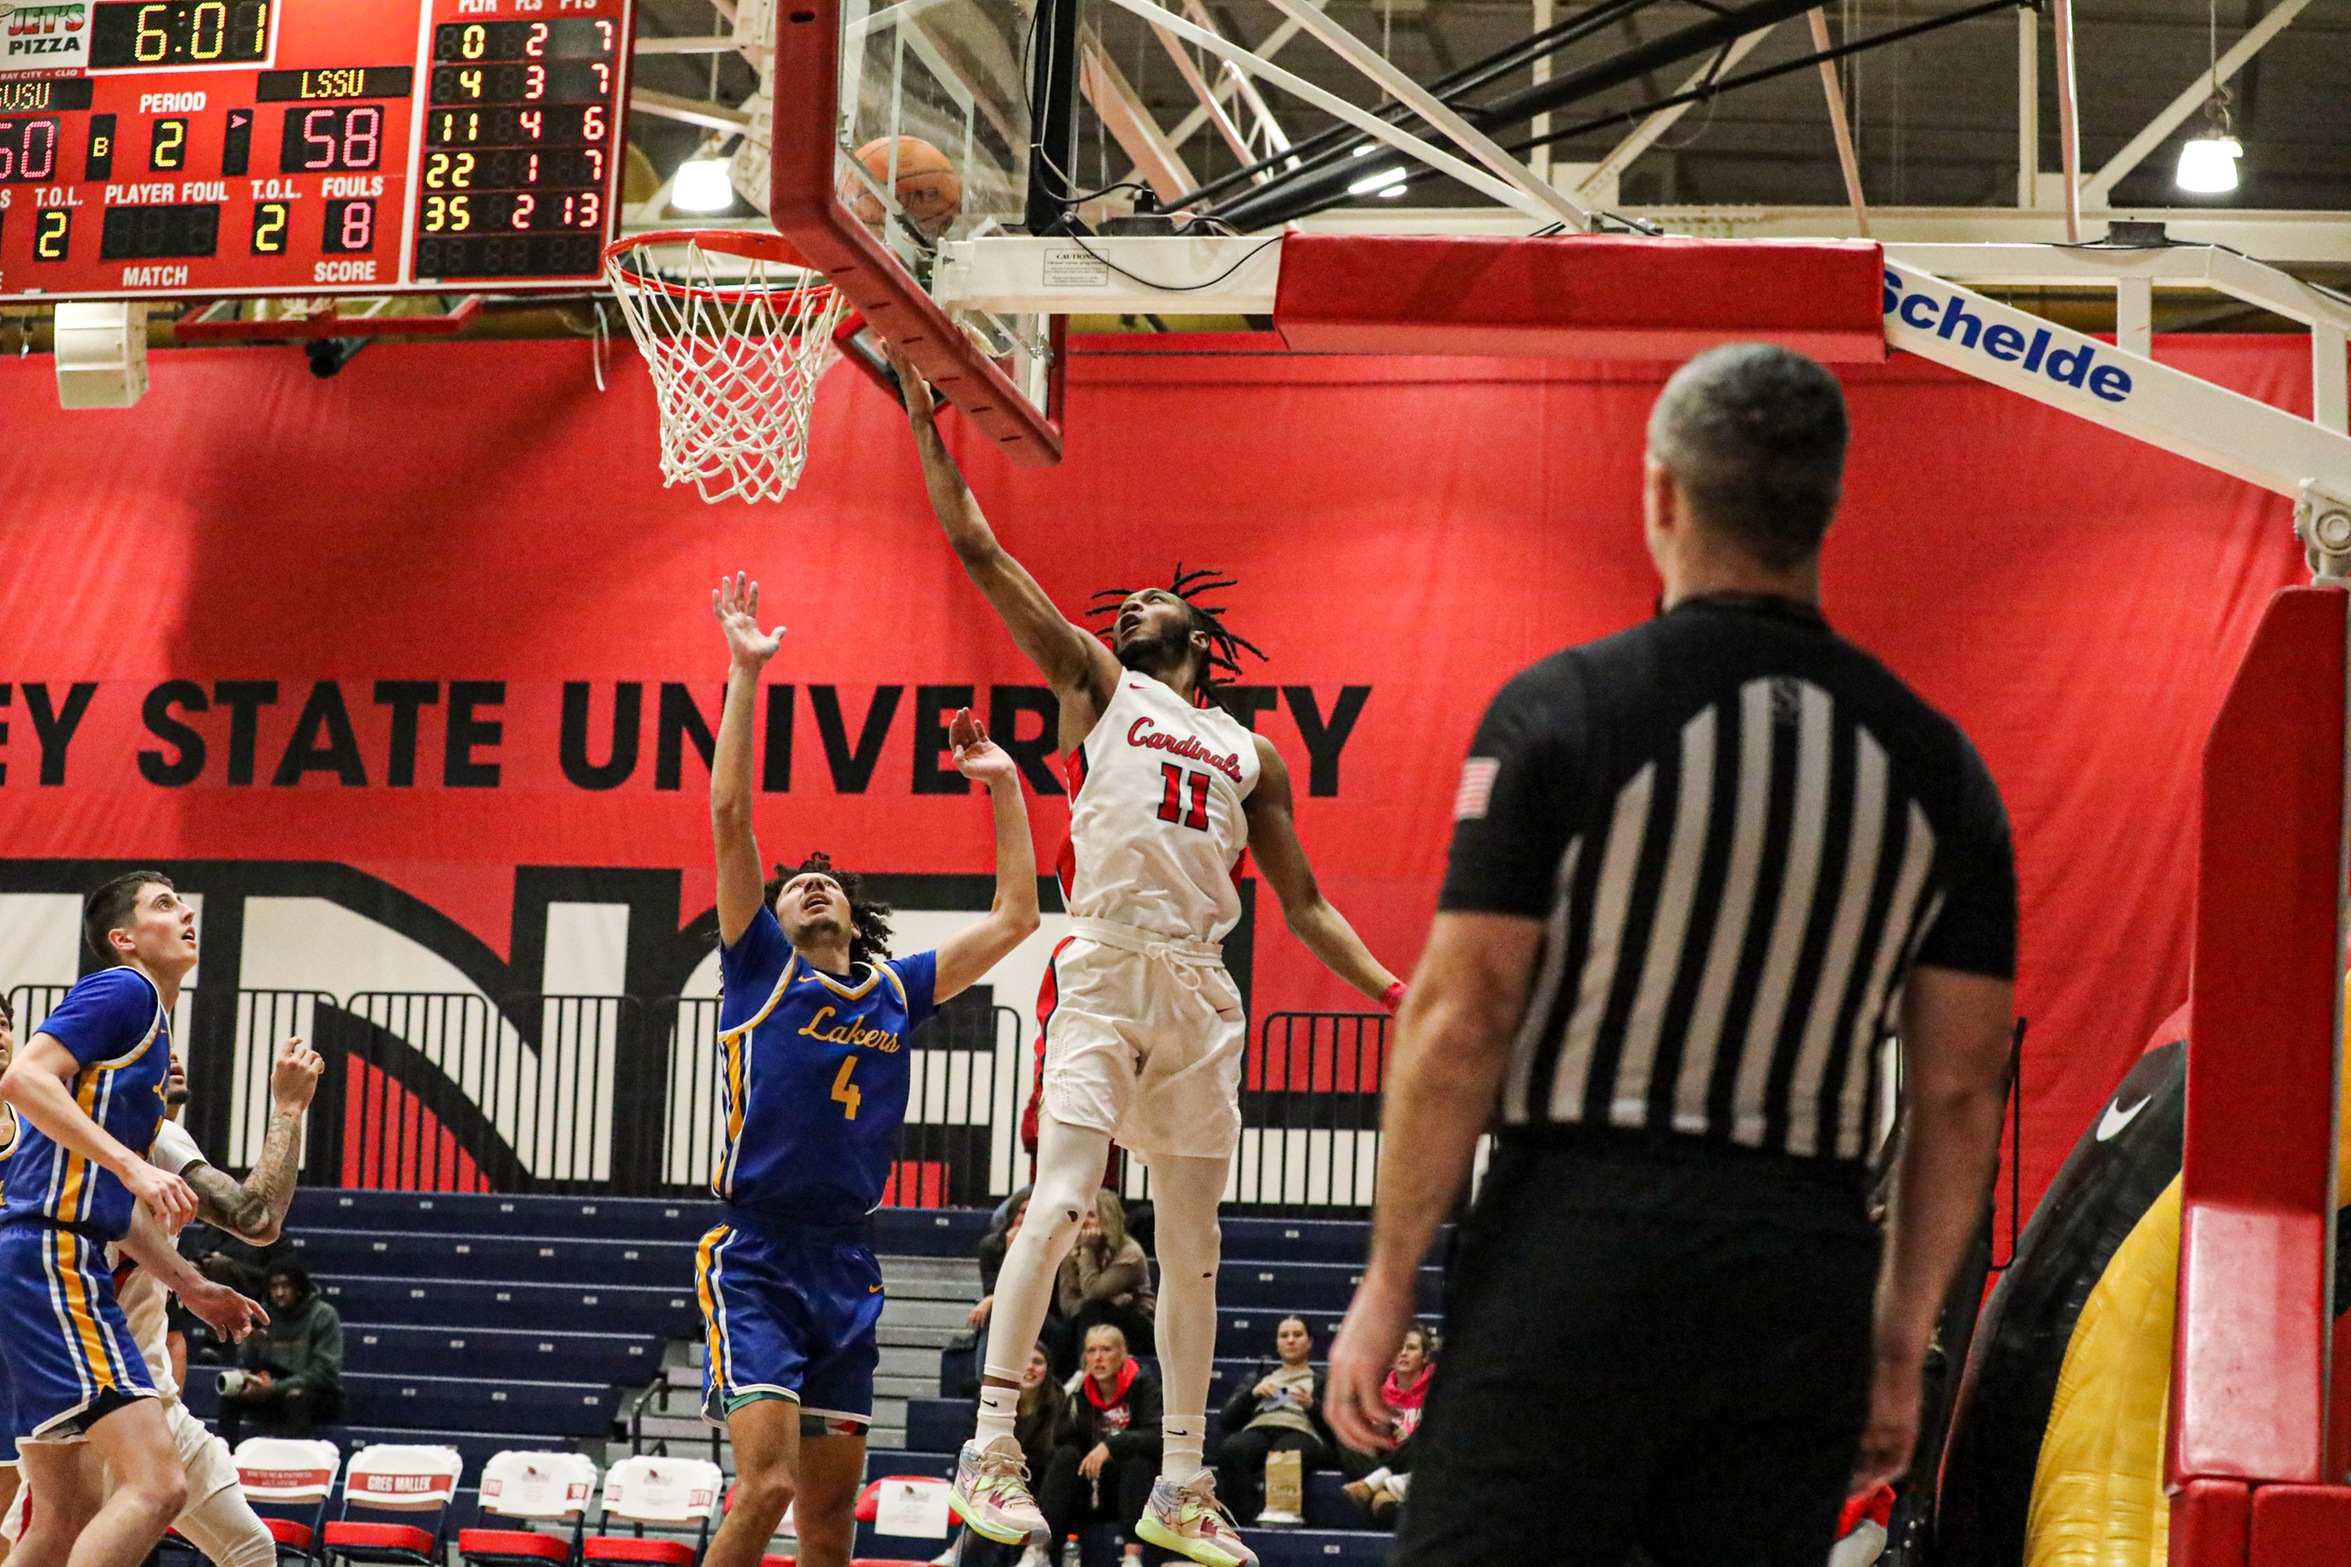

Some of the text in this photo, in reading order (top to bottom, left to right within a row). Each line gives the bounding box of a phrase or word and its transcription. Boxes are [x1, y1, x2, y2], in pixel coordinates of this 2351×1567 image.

[8, 3, 85, 36] JET'S
[135, 2, 267, 62] 6:01
[9, 37, 80, 56] PIZZA
[462, 20, 613, 59] 0 2 7
[0, 69, 79, 80] BAY CITY CLIO
[300, 69, 365, 98] LSSU
[460, 63, 610, 99] 4 3 7
[0, 82, 50, 110] VSU
[139, 91, 207, 114] PERIOD
[304, 107, 379, 169] 58
[443, 106, 605, 142] 11 4 6
[93, 136, 109, 157] B
[155, 121, 183, 168] 2
[426, 149, 603, 188] 22 1 7
[35, 186, 84, 208] T.O.L.
[105, 181, 230, 204] PLAYER FOUL
[251, 178, 302, 200] T.O.L.
[321, 176, 384, 198] FOULS
[255, 204, 286, 251] 2
[341, 202, 372, 249] 8
[425, 192, 599, 232] 35 2 13
[39, 211, 67, 257] 2
[122, 266, 189, 287] MATCH
[314, 260, 377, 283] SCORE
[137, 679, 506, 788] STATE
[559, 681, 1373, 798] UNIVERTY
[1127, 716, 1243, 784] Cardinals
[1156, 761, 1211, 832] 11
[798, 1006, 901, 1053] Lakers
[831, 1055, 862, 1121] 4
[367, 1475, 393, 1492] GREG
